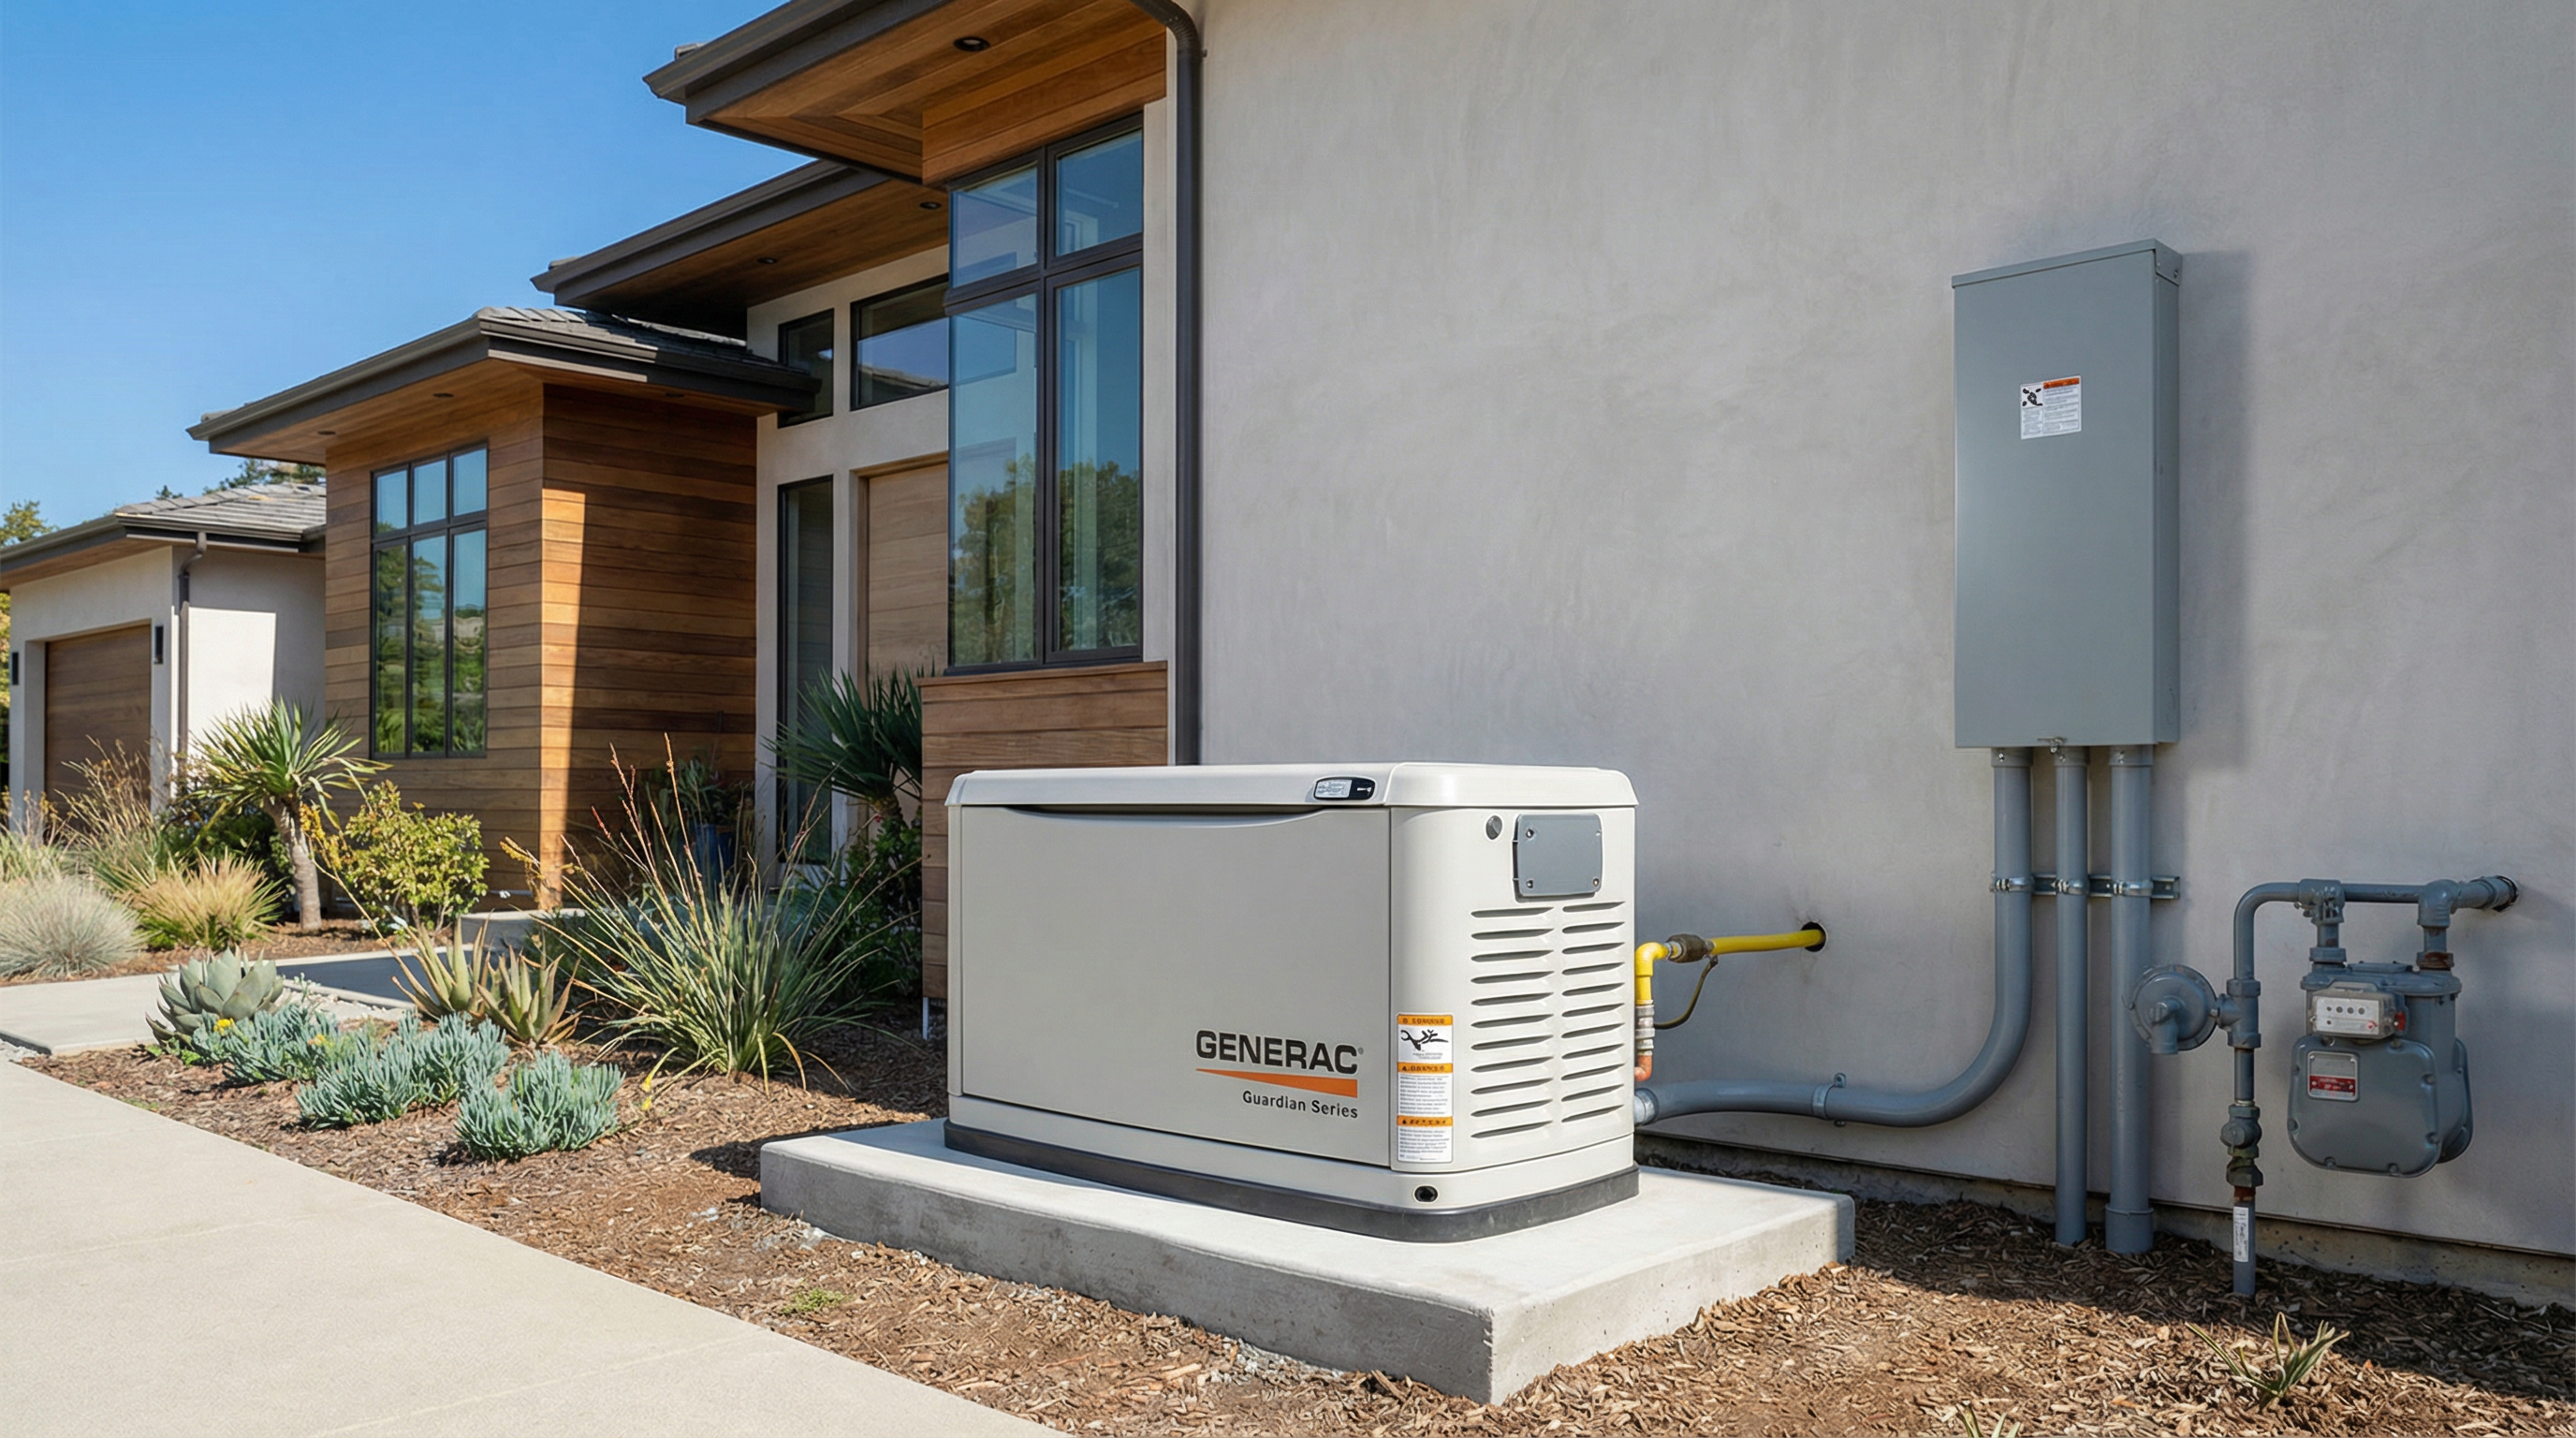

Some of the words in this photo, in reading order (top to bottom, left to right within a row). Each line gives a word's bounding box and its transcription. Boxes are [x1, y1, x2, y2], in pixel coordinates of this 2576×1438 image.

[1196, 1030, 1357, 1074] GENERAC
[1242, 1090, 1306, 1111] Guardian
[1311, 1100, 1358, 1119] Series
